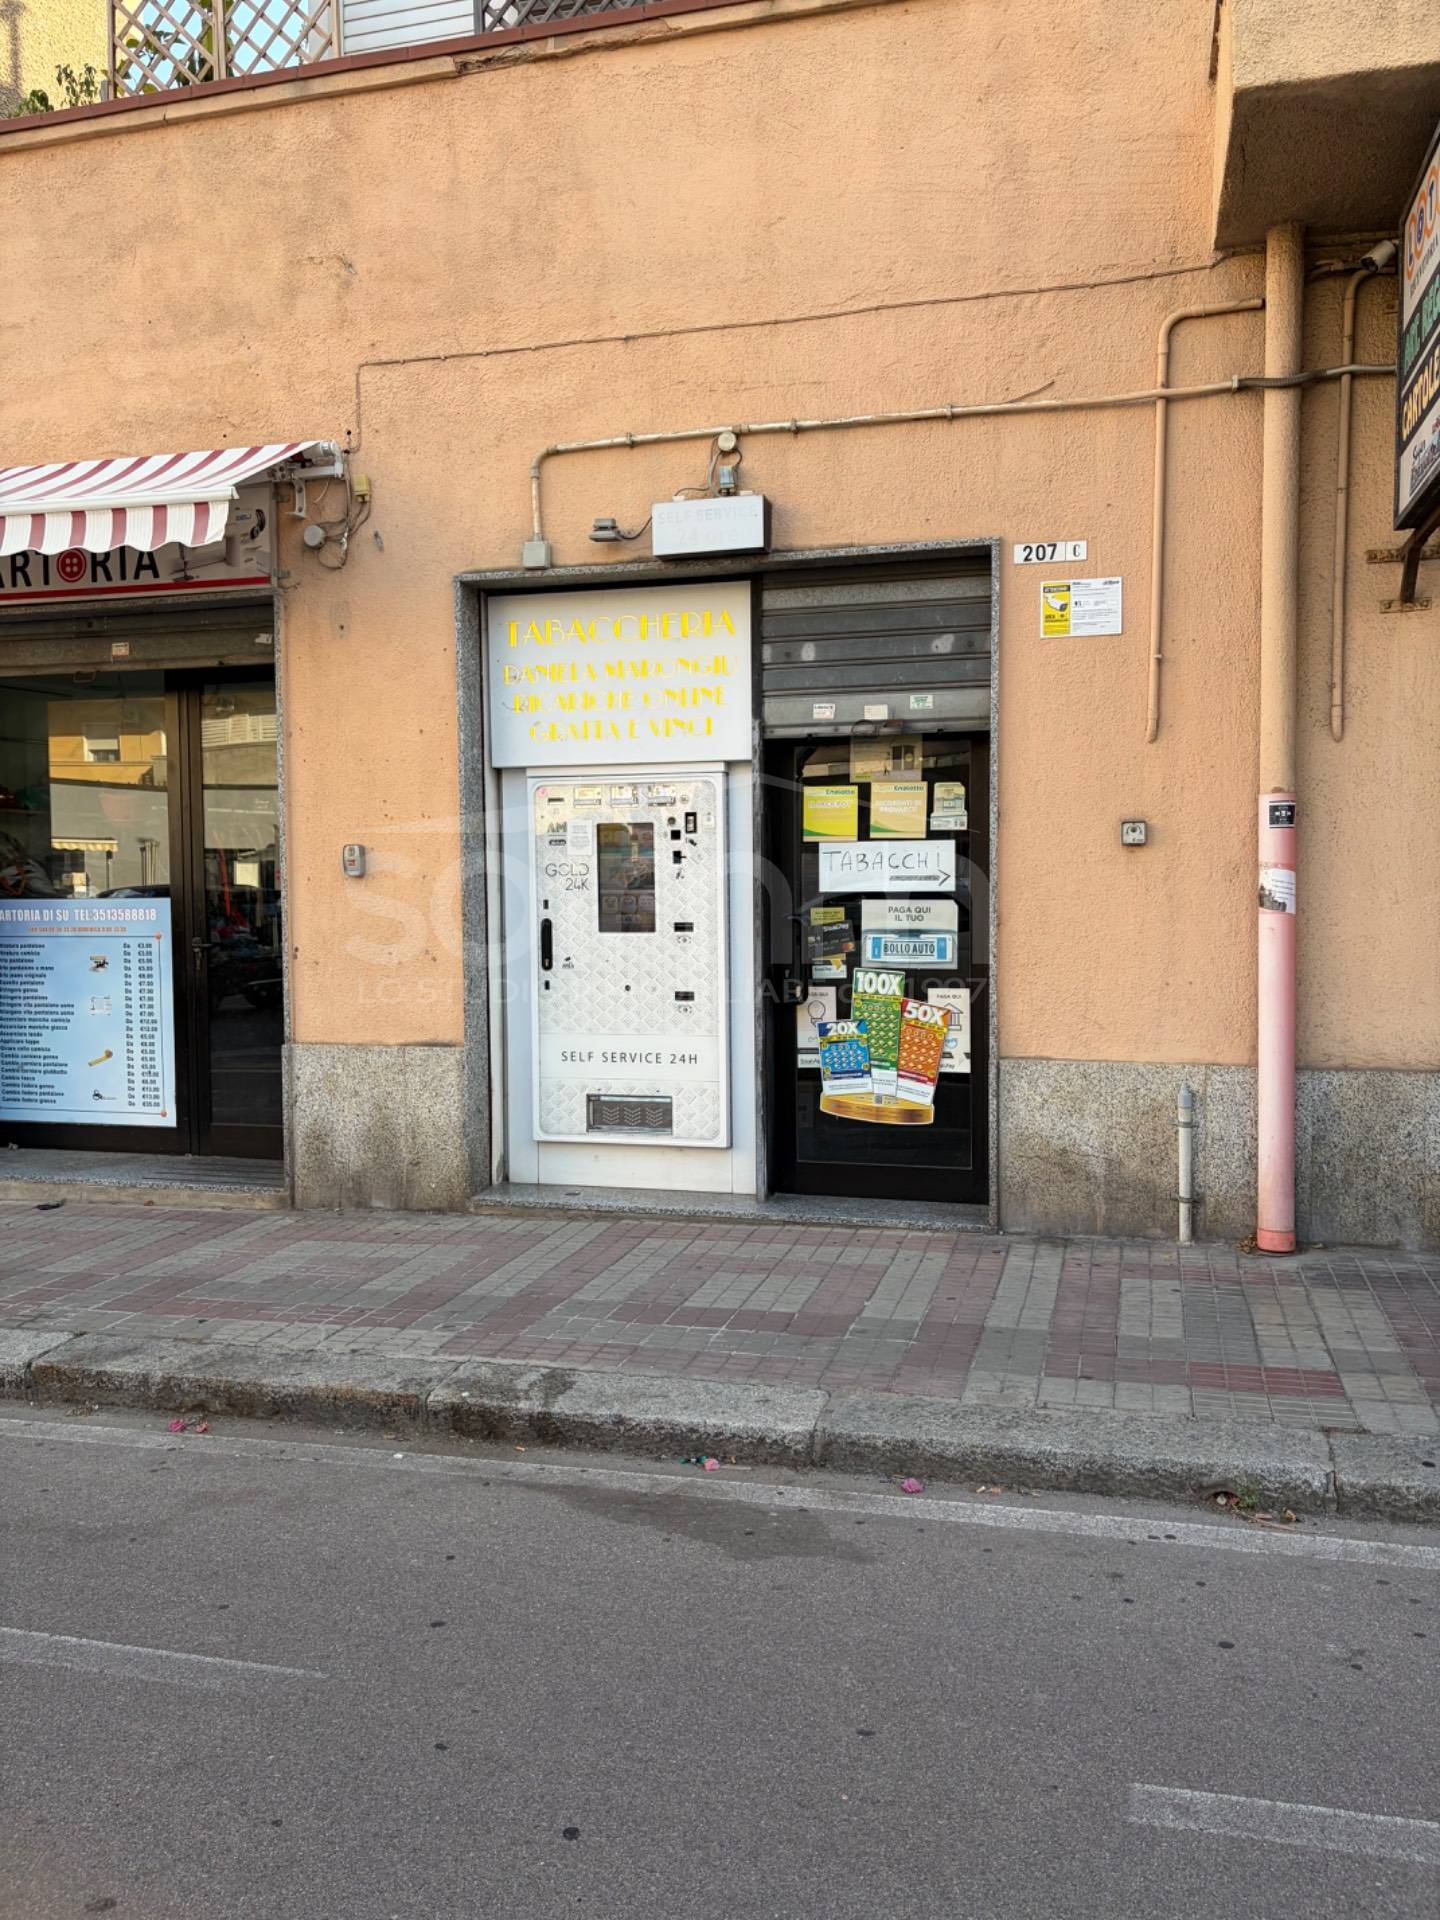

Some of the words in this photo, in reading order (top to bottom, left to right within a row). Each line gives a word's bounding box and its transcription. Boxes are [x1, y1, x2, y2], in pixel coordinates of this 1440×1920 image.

[1023, 543, 1057, 562] 207
[1073, 544, 1081, 557] C
[0, 546, 160, 589] RTORIA
[506, 609, 737, 648] TABACCHERIA
[502, 661, 598, 686] DANIELA
[604, 655, 737, 682] MARONGIU
[513, 689, 637, 715] RICARICHE
[642, 685, 728, 710] ONLINE
[647, 715, 713, 739] VINCI
[545, 863, 589, 878] GOLD
[565, 877, 589, 891] 24K
[894, 914, 903, 922] IL
[905, 914, 925, 922] TUO
[914, 905, 931, 914] QUI
[883, 941, 911, 955] BOLLO
[912, 942, 936, 955] AUTO
[855, 971, 903, 995] 100X
[903, 1000, 946, 1026] 50X
[826, 1021, 859, 1036] 20X
[561, 1050, 594, 1063] SELF
[602, 1052, 662, 1064] SERVICE
[669, 1053, 698, 1065] 24H
